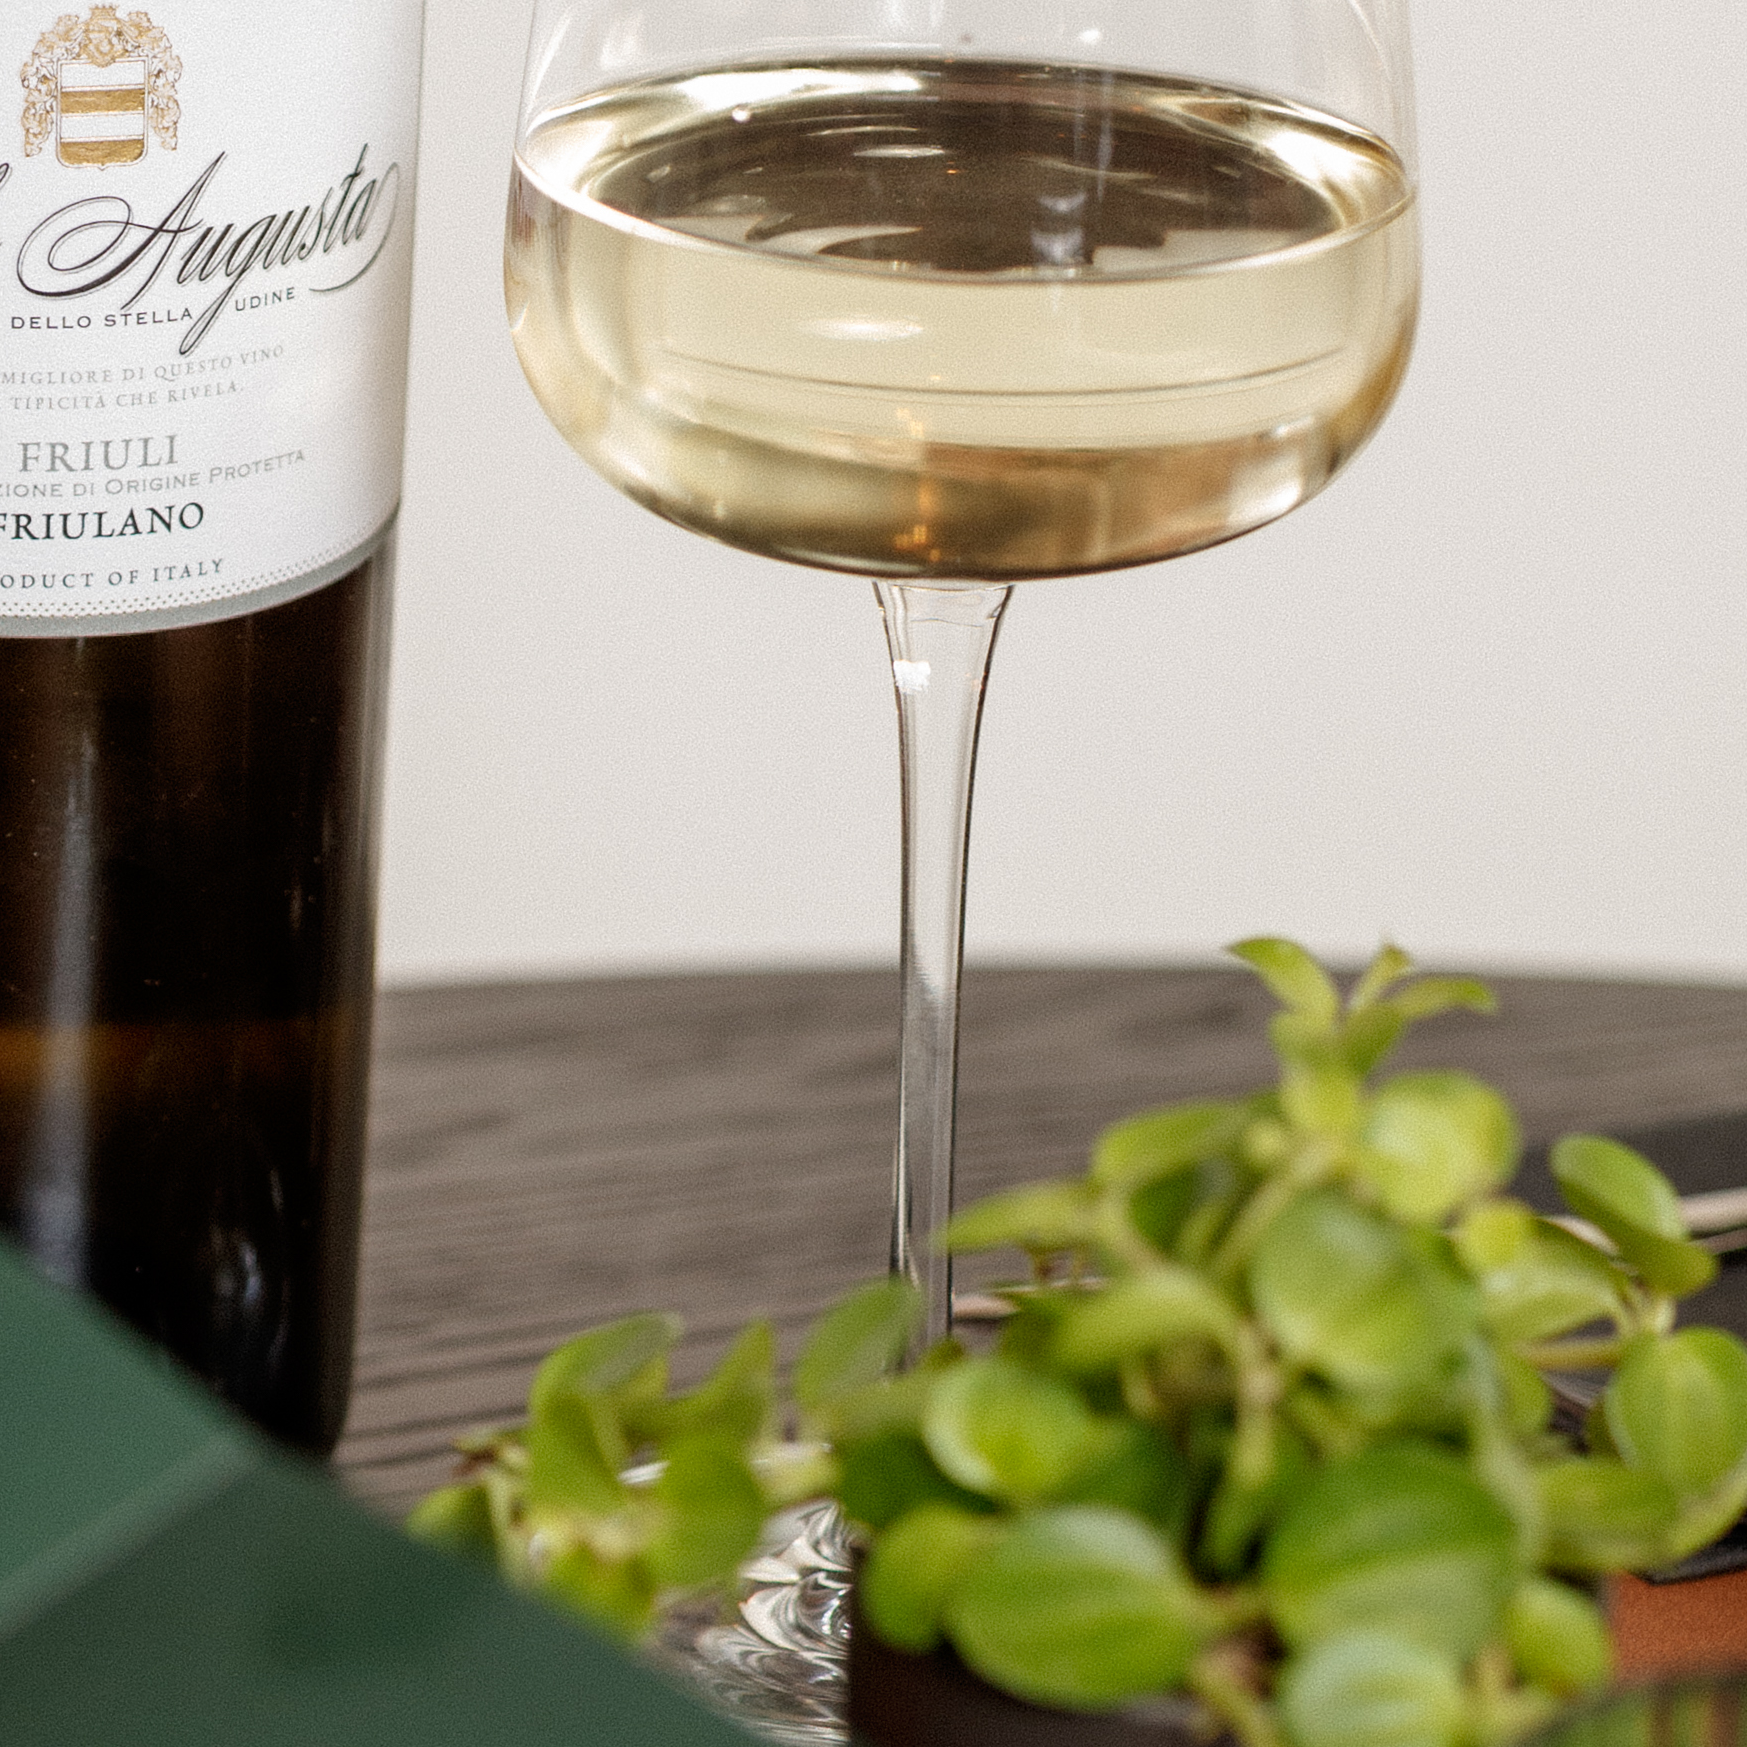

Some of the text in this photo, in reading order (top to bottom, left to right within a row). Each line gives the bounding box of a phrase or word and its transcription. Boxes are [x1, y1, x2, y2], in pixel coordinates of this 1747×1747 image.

[17, 143, 400, 356] Augusta
[11, 314, 92, 330] DELLO
[103, 307, 193, 328] STELLA
[234, 286, 296, 312] UDINE
[1, 370, 113, 385] MIGLIORE
[122, 367, 145, 382] DI
[154, 356, 232, 383] QUESTO
[240, 344, 285, 366] VINO
[115, 391, 158, 407] CHE
[17, 434, 179, 473] FRIULI
[108, 569, 140, 586] OF
[153, 558, 224, 582] ITALY
